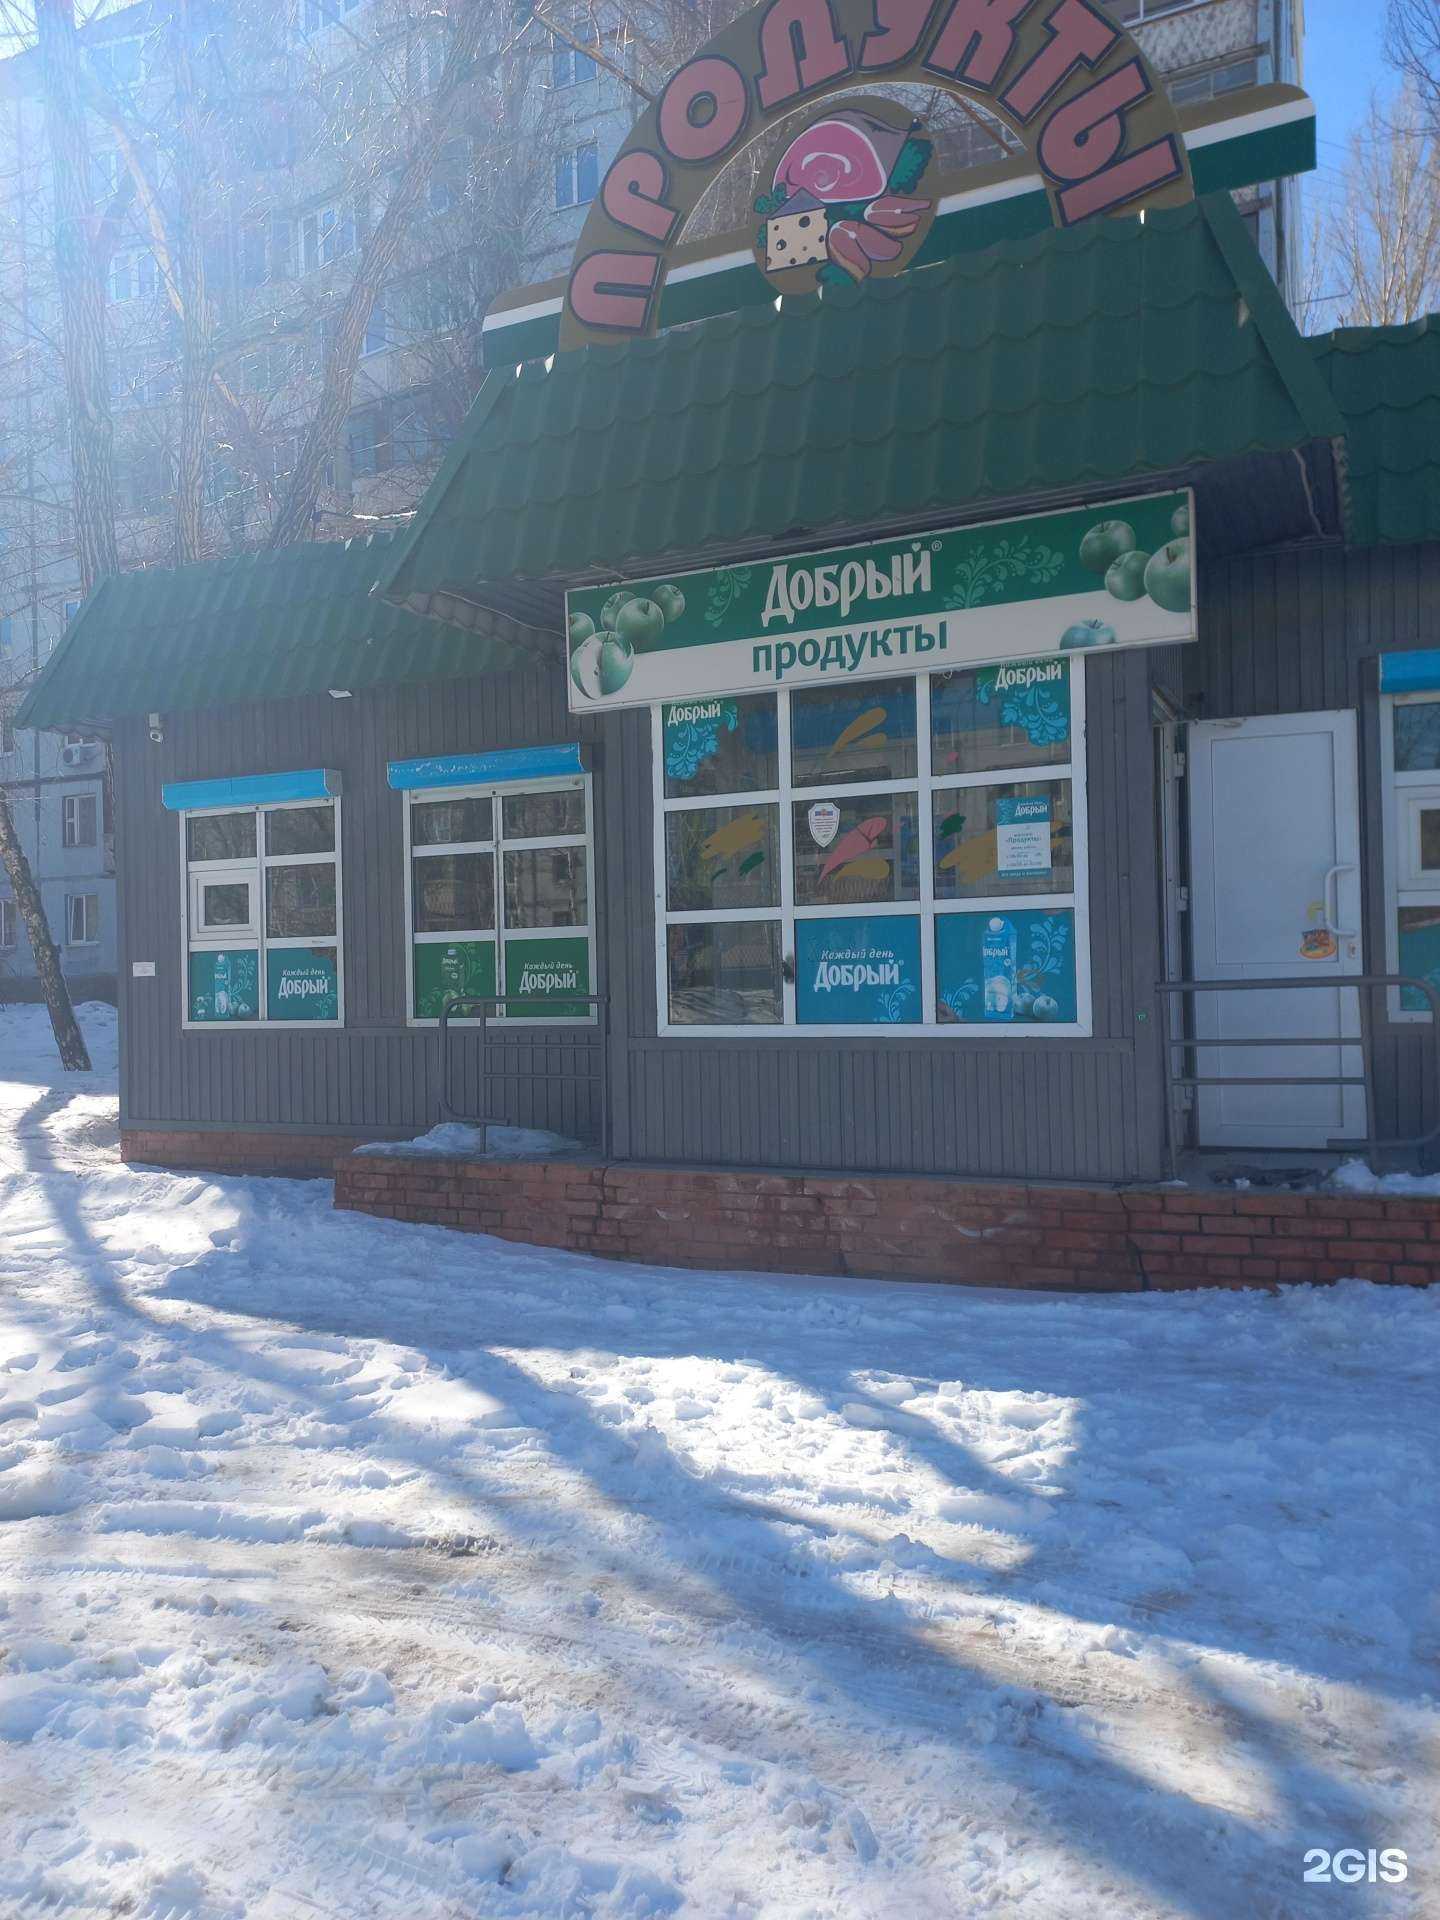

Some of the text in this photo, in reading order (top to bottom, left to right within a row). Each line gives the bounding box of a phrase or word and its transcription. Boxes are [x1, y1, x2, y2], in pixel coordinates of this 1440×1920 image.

[753, 621, 947, 680] продукты
[821, 948, 895, 960] Каждый день
[524, 960, 573, 970] Каждый день
[310, 967, 326, 976] день
